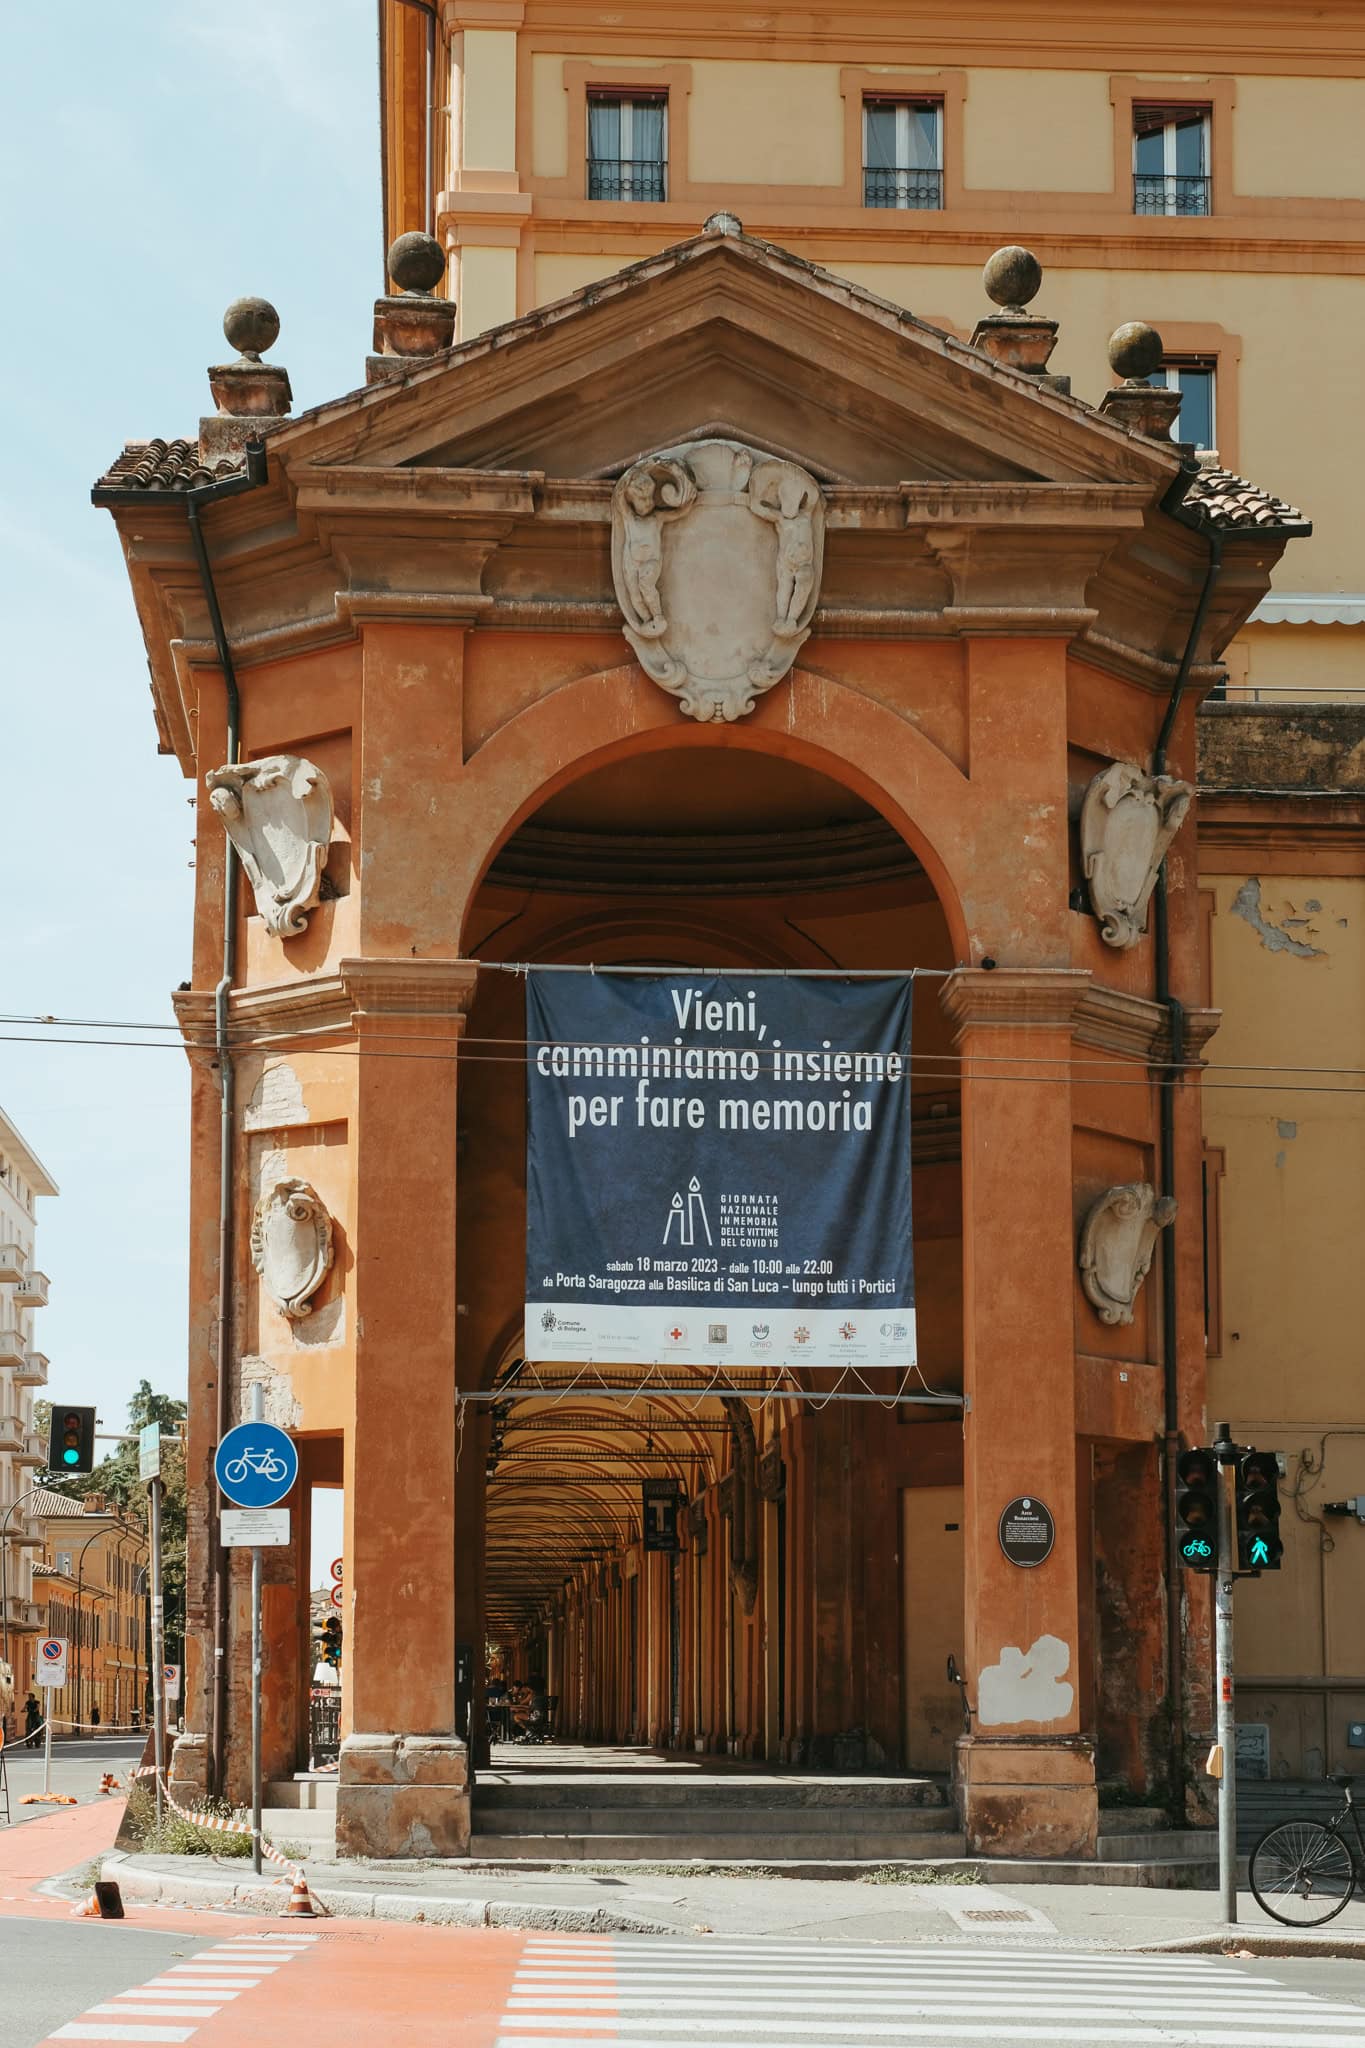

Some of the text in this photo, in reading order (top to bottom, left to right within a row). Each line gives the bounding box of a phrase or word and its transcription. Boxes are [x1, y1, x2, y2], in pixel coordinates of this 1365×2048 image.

[671, 989, 767, 1040] Vieni,
[536, 1036, 904, 1083] camminiamo insieme
[568, 1079, 873, 1138] per fare memoria
[720, 1194, 778, 1204] GIORNATA
[720, 1205, 778, 1215] NAZIONALE
[720, 1216, 778, 1226] IN MEMORIA
[721, 1227, 779, 1237] DELLE VITTIME
[720, 1238, 779, 1248] DEL COVID 19
[606, 1260, 634, 1271] sabato
[636, 1257, 651, 1272] 18
[653, 1260, 688, 1272] marzo
[691, 1258, 718, 1273] 2023
[729, 1262, 750, 1274] dalle
[752, 1259, 783, 1274] 10:00
[785, 1263, 801, 1274] alle
[803, 1260, 833, 1275] 22:00
[543, 1276, 554, 1287] da
[556, 1273, 586, 1288] Porta
[588, 1274, 646, 1293] Saragozza
[648, 1279, 664, 1290] alla
[666, 1276, 711, 1292] Basilica
[713, 1278, 724, 1292] di
[727, 1278, 748, 1293] San
[751, 1278, 779, 1293] Luca
[792, 1278, 823, 1296] lungo
[826, 1279, 848, 1294] tutti
[852, 1279, 856, 1294] i
[859, 1279, 896, 1294] Portici
